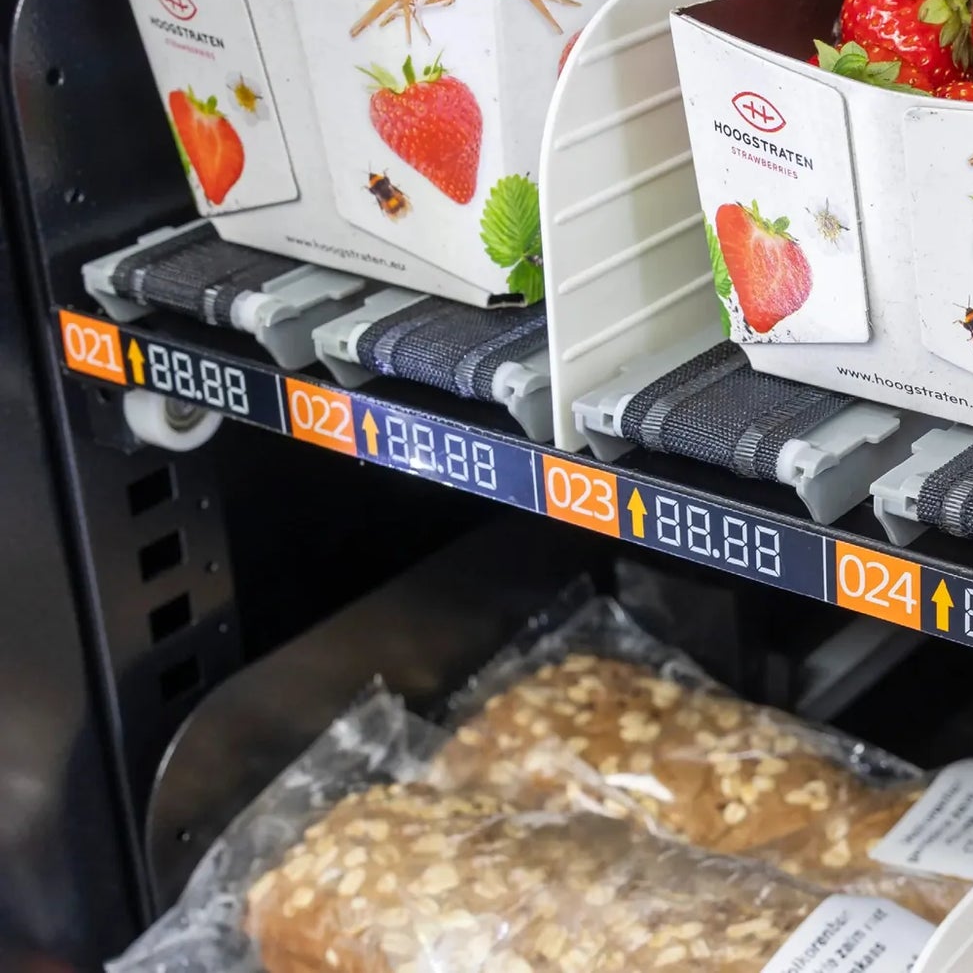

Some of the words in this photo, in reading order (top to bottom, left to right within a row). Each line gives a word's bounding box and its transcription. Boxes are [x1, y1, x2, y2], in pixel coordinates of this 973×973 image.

[713, 120, 814, 171] HOOGSTRATEN
[731, 146, 798, 180] STRAWBERRIES
[64, 323, 123, 373] 021
[148, 345, 250, 415] 88.88
[291, 389, 353, 443] 022
[547, 466, 615, 522] 023
[655, 495, 781, 578] 88.88
[838, 554, 917, 615] 024
